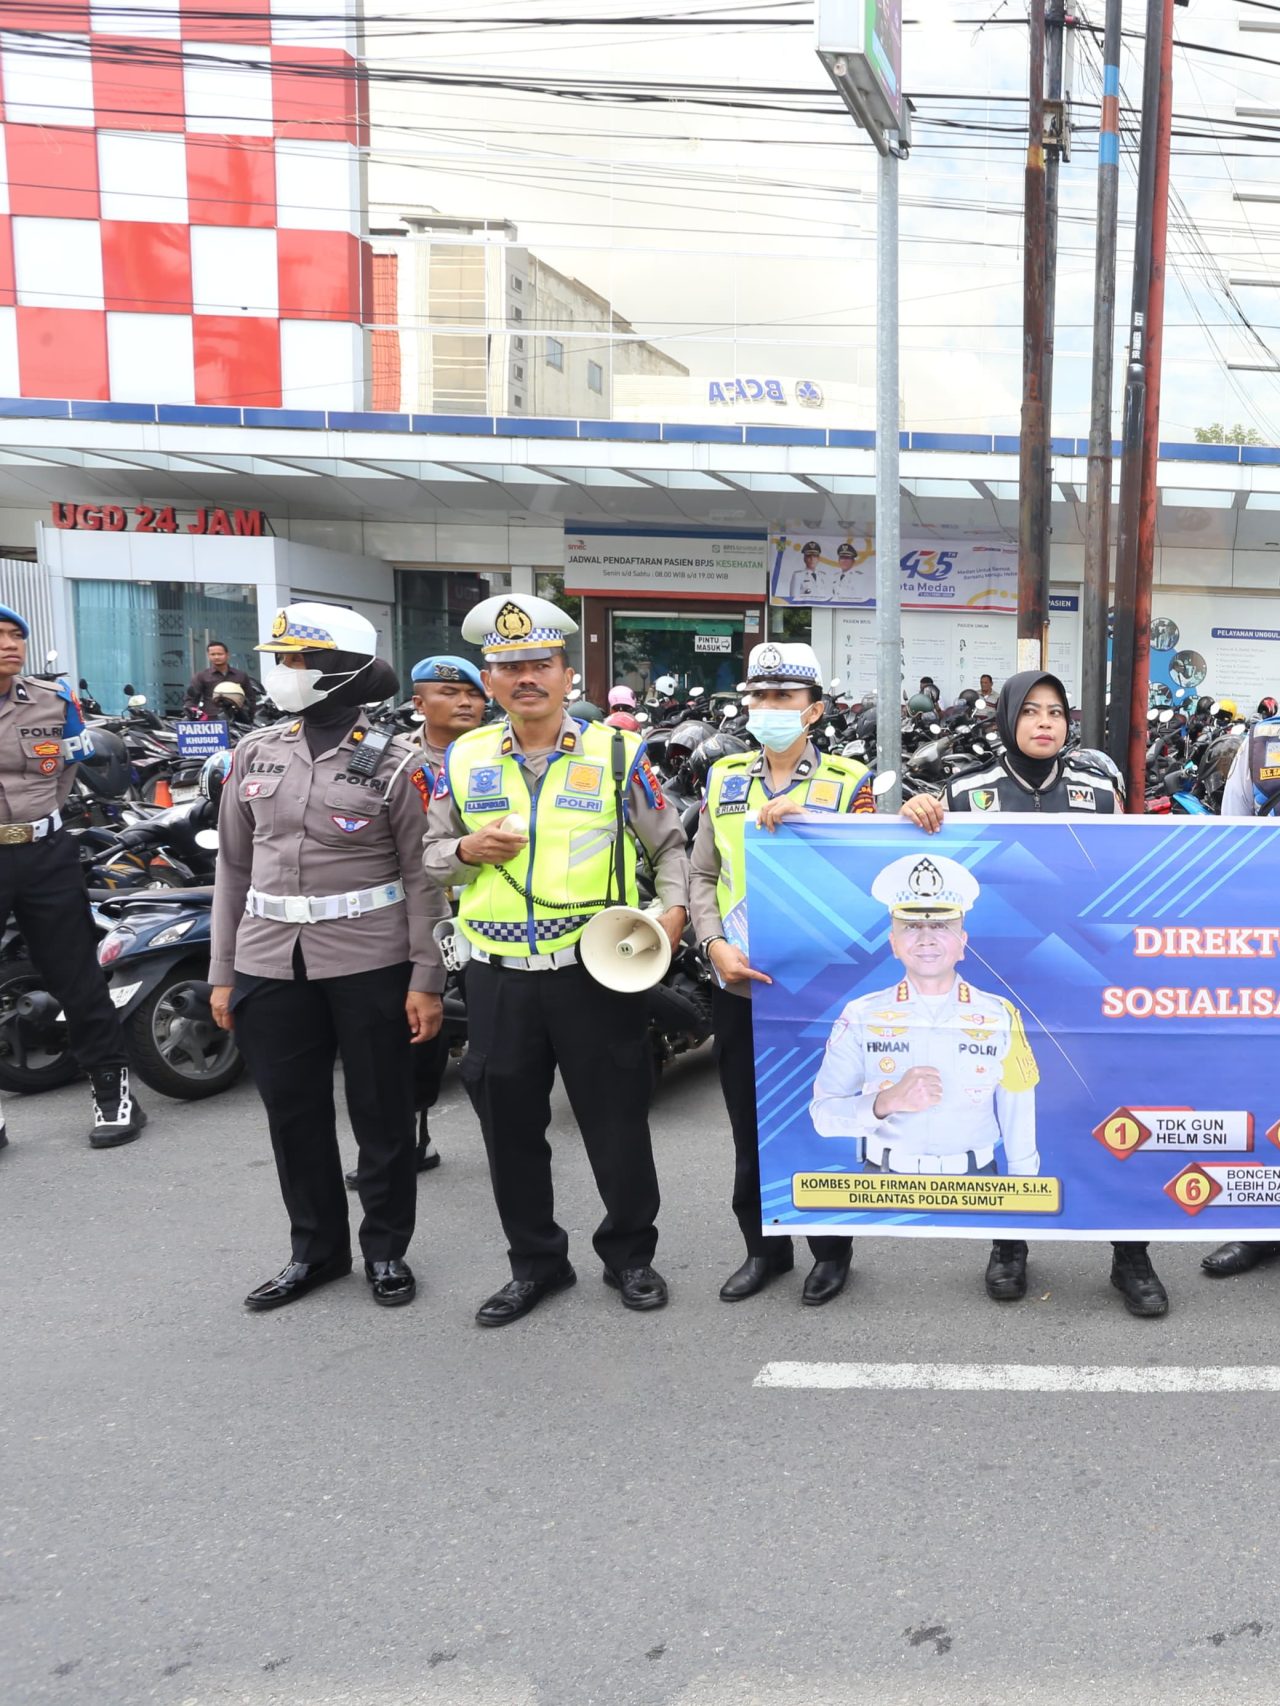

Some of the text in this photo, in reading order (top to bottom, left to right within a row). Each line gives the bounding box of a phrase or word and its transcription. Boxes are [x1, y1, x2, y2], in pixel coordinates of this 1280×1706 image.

[52, 502, 263, 536] UGD 24 JAM
[568, 555, 763, 569] JADWAL PENDAFTARAN PASIEN BPJS KESEHATAN
[917, 582, 955, 592] Medan
[1217, 629, 1254, 638] PELAYANAN
[20, 727, 63, 738] POLRI
[178, 723, 224, 735] PARKIR
[185, 736, 219, 744] KHUSUS
[333, 773, 386, 791] POLRI
[1070, 789, 1094, 801] DVI
[557, 798, 600, 810] POLRI
[866, 1041, 910, 1053] FIRMAN
[958, 1043, 998, 1056] POLRI
[1156, 1119, 1225, 1131] TDK GUN
[1114, 1123, 1127, 1145] 1
[1156, 1133, 1227, 1145] HELM SNI
[801, 1178, 1052, 1195] KOMBES POL FIRMAN DARMANSYAH, S.I.K.
[1185, 1177, 1201, 1201] 6
[1226, 1181, 1265, 1191] LEBIH
[849, 1193, 1004, 1207] DIRLANTAS POLDA SUMUT
[1227, 1192, 1233, 1202] 1
